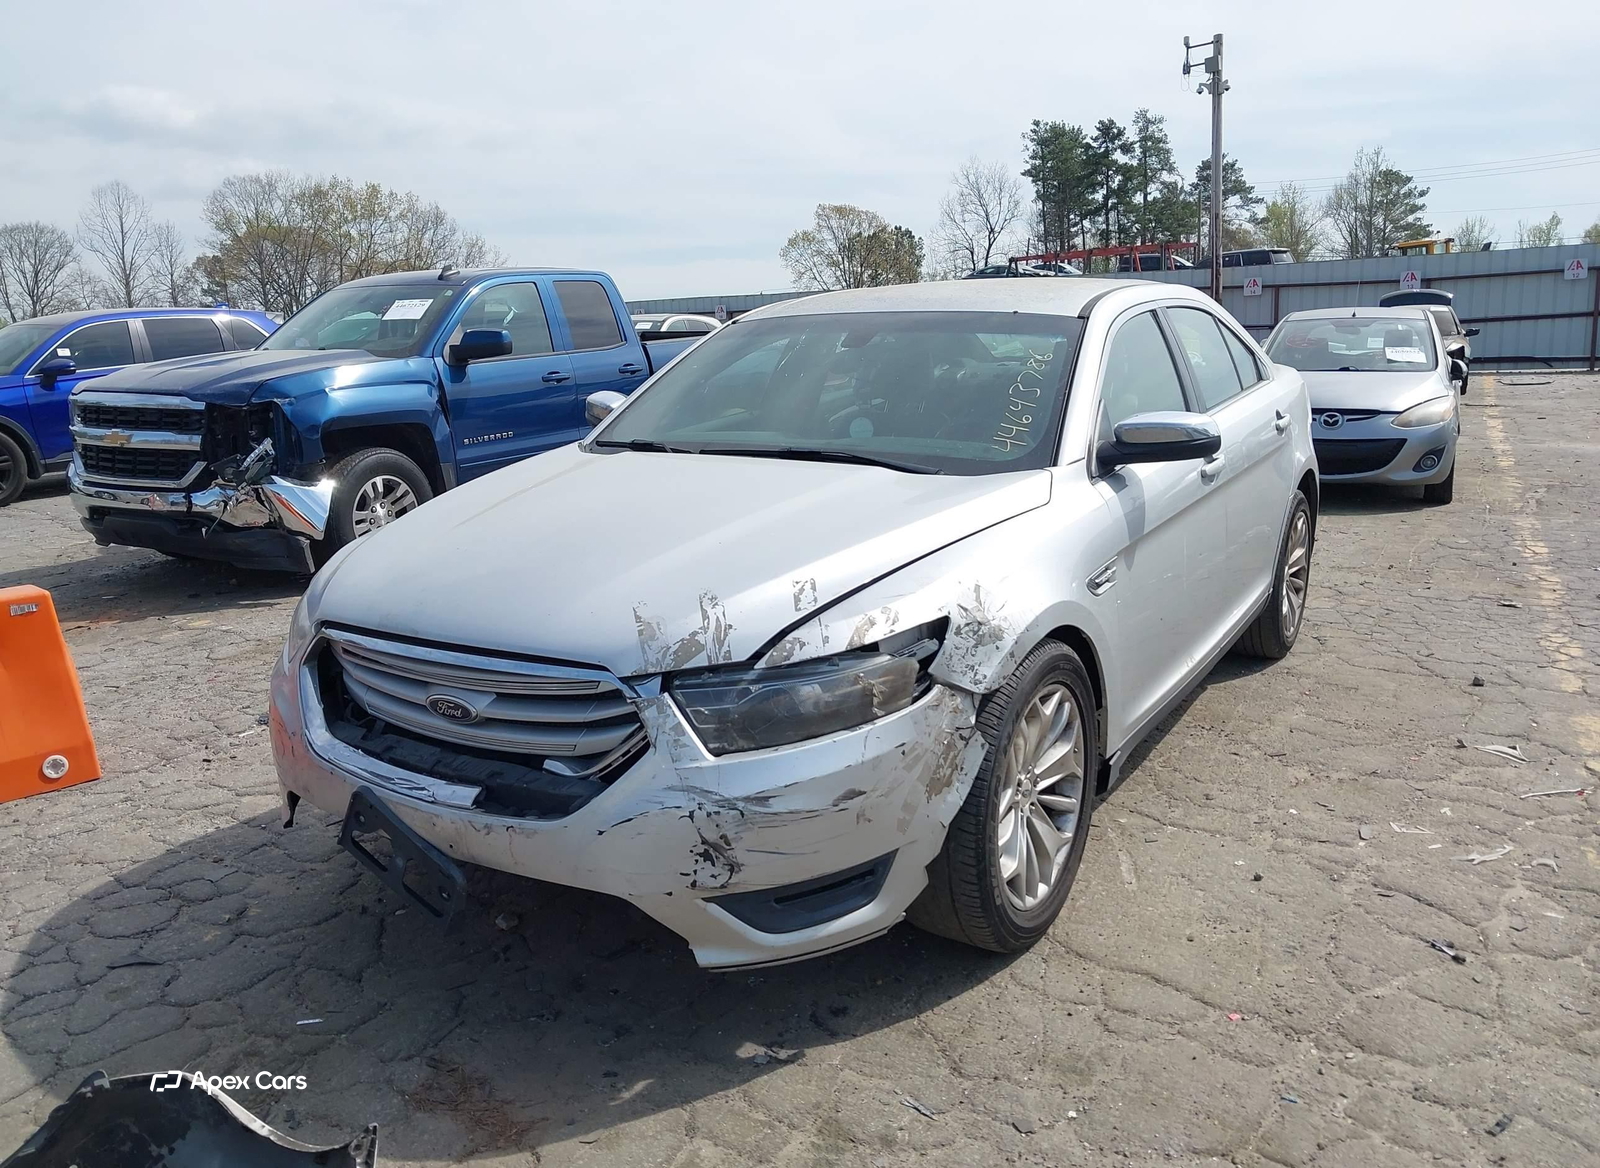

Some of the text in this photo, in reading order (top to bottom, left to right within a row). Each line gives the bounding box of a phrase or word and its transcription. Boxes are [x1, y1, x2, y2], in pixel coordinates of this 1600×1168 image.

[991, 349, 1053, 452] 44643786
[463, 431, 514, 445] SILVERADO
[436, 700, 463, 718] Ford
